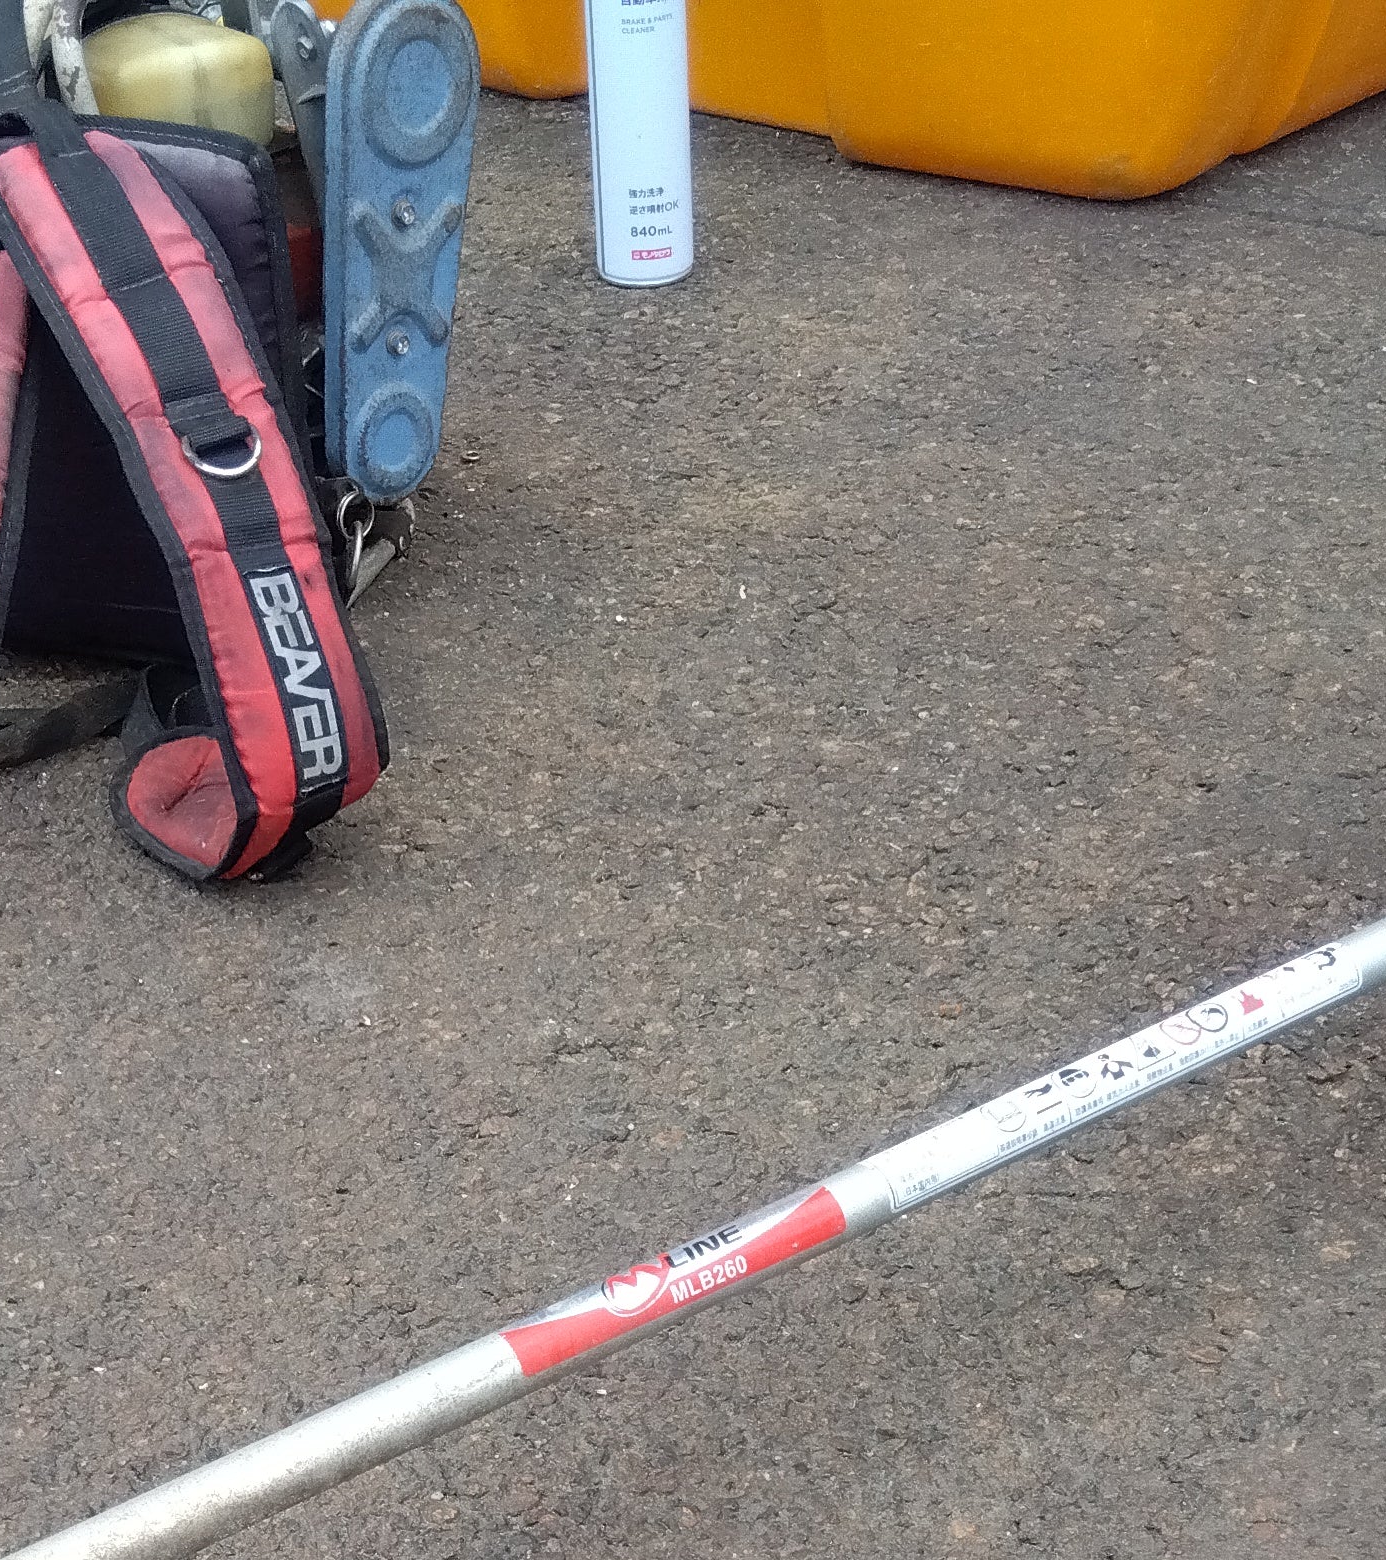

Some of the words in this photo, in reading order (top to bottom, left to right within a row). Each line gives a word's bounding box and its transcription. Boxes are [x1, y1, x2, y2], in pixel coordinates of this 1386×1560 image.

[621, 26, 654, 34] CLEANER
[630, 225, 673, 238] 840mL
[250, 572, 343, 780] BEAVER
[665, 1225, 743, 1268] LINE
[669, 1254, 748, 1304] MLB260
